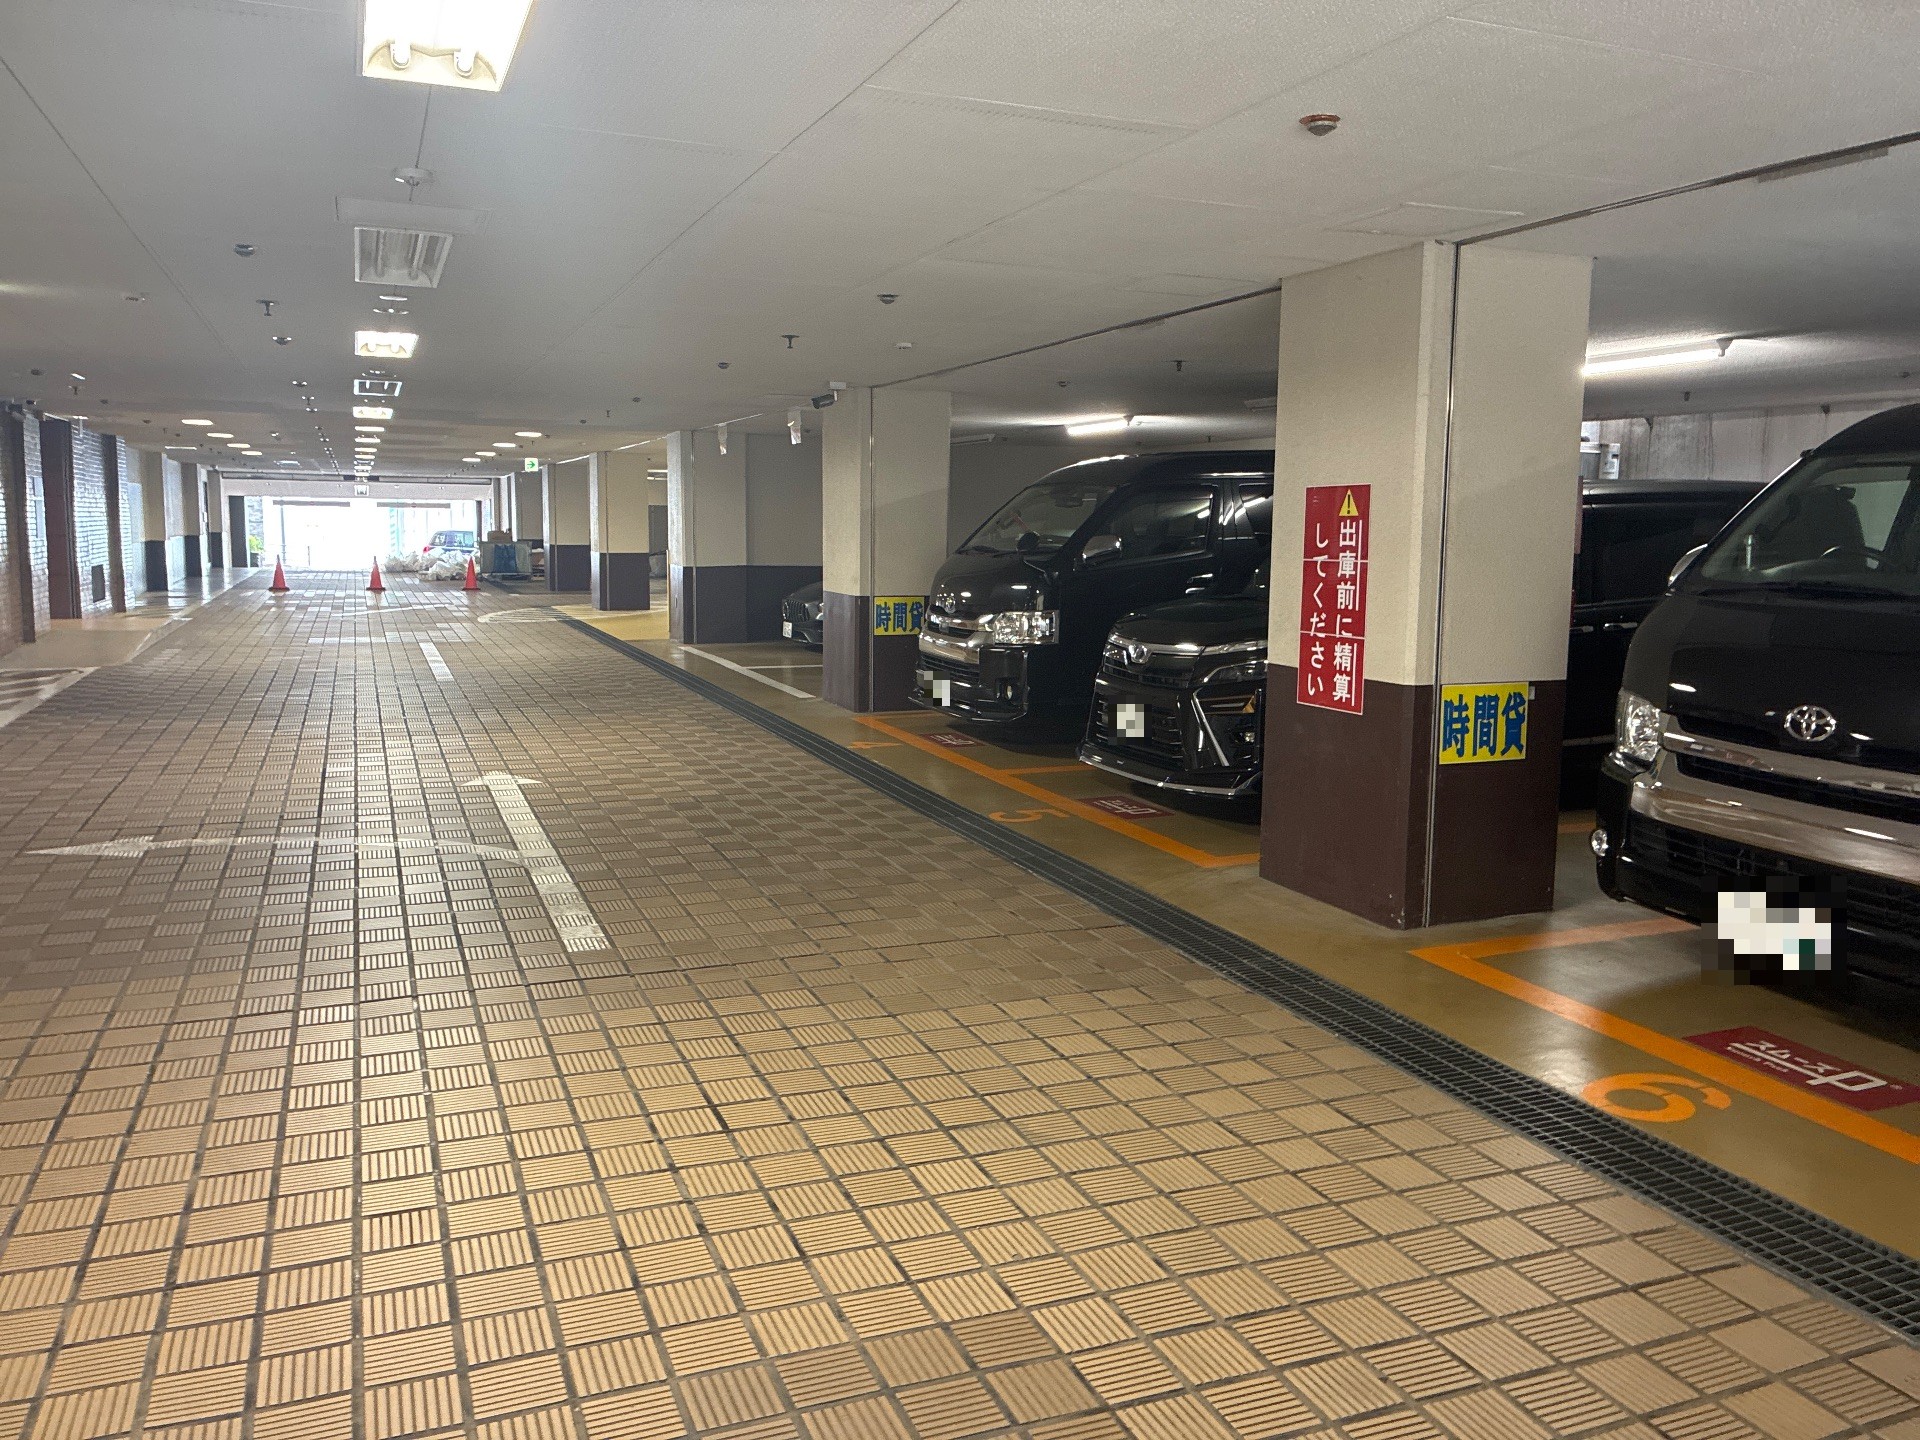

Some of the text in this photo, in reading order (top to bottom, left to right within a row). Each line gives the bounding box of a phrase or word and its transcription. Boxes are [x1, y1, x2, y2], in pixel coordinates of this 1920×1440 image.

[875, 601, 923, 632] 時間貸
[1307, 523, 1329, 696] してください
[1332, 519, 1357, 703] 出庫前に精算
[1442, 691, 1526, 758] 時間貸
[988, 808, 1070, 823] 5
[1581, 1072, 1732, 1123] 6
